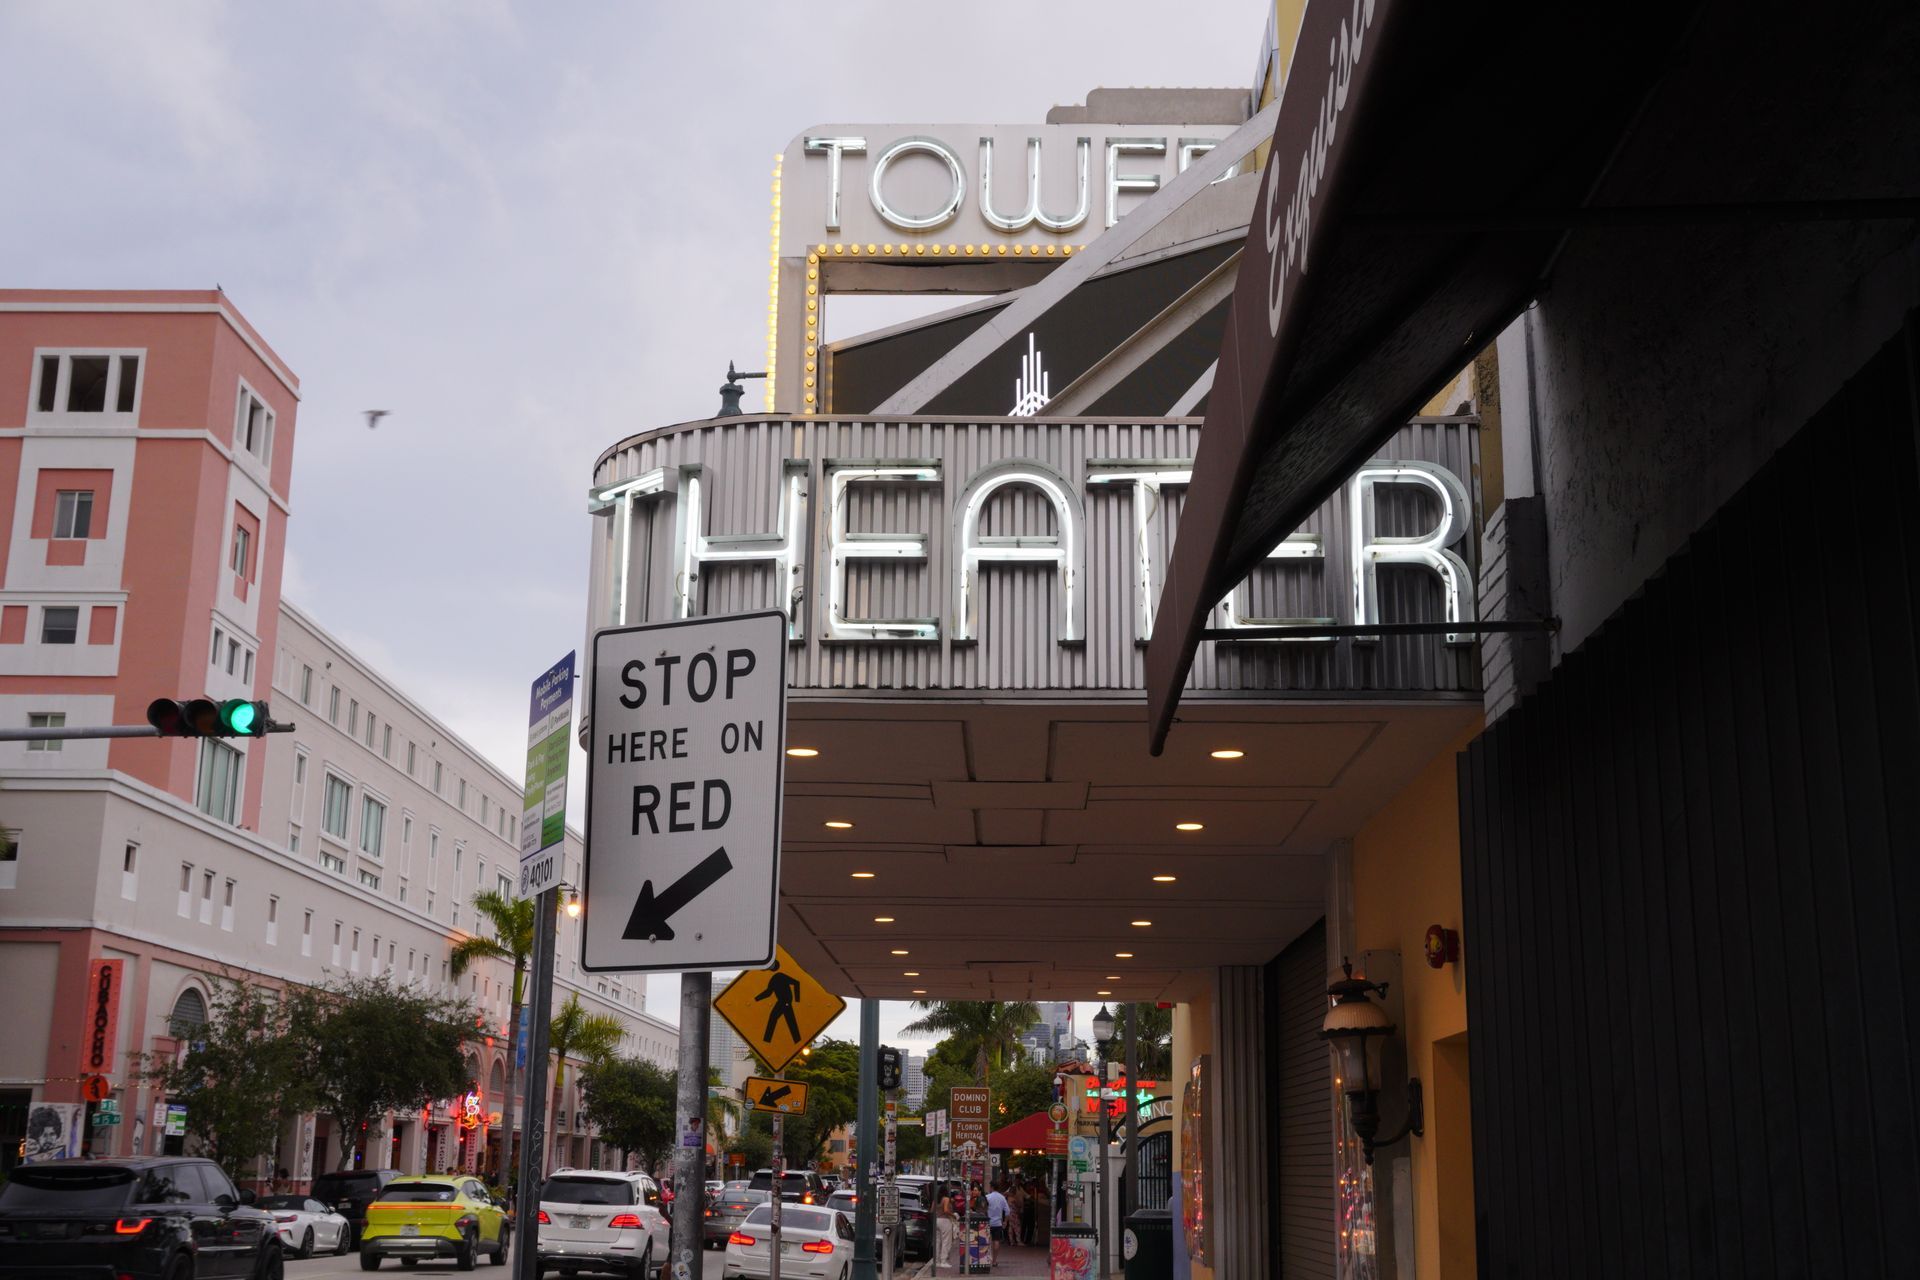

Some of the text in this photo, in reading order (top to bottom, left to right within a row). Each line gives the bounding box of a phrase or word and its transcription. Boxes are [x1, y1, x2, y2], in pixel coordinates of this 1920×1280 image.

[551, 667, 569, 687] Parking
[619, 648, 756, 710] STOP
[540, 687, 562, 711] Payments
[607, 727, 689, 764] HERE
[721, 720, 763, 754] ON
[632, 778, 732, 836] RED
[91, 965, 112, 1068] CUBAOCHO
[953, 1093, 987, 1102] DOMINO
[959, 1105, 982, 1114] CLUB
[955, 1131, 984, 1140] HERITAGE
[957, 1122, 983, 1131] FLORIDA
